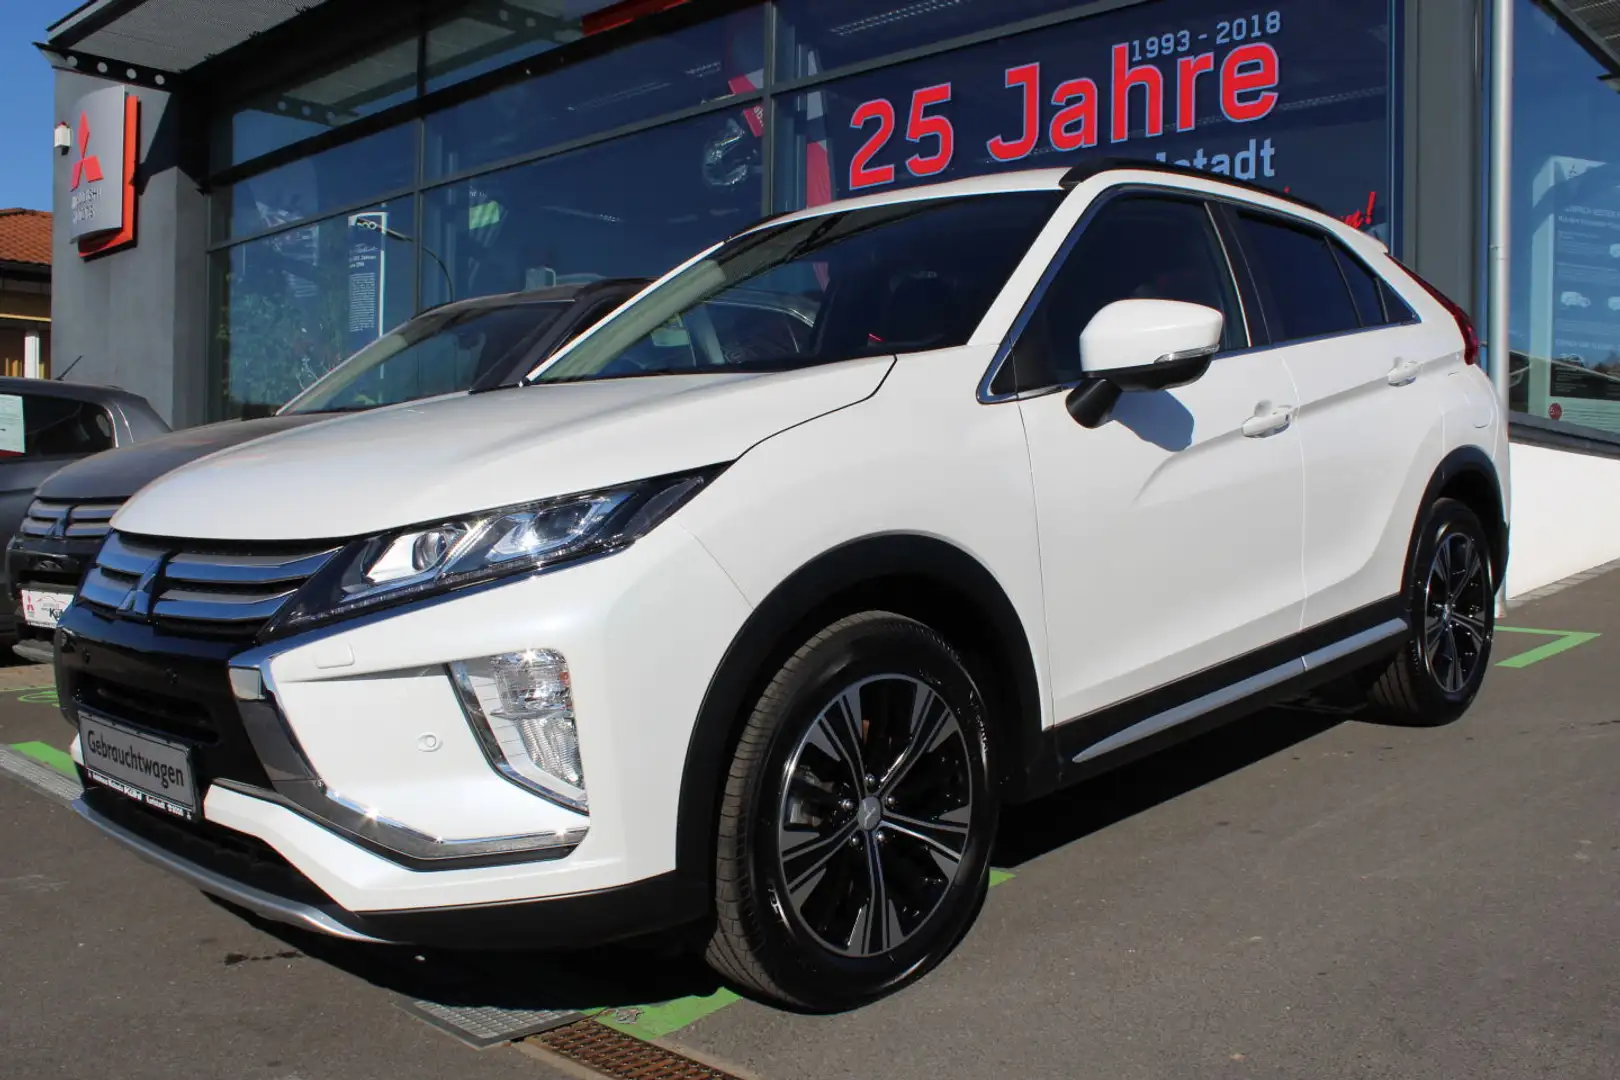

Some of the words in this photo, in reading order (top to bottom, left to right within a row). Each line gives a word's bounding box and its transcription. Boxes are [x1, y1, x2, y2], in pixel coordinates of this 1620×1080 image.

[1132, 29, 1190, 62] 1993
[1216, 10, 1281, 44] 2018
[849, 83, 954, 190] 25
[986, 42, 1280, 163] Jahre
[87, 730, 185, 789] Gebrauchtwagen
